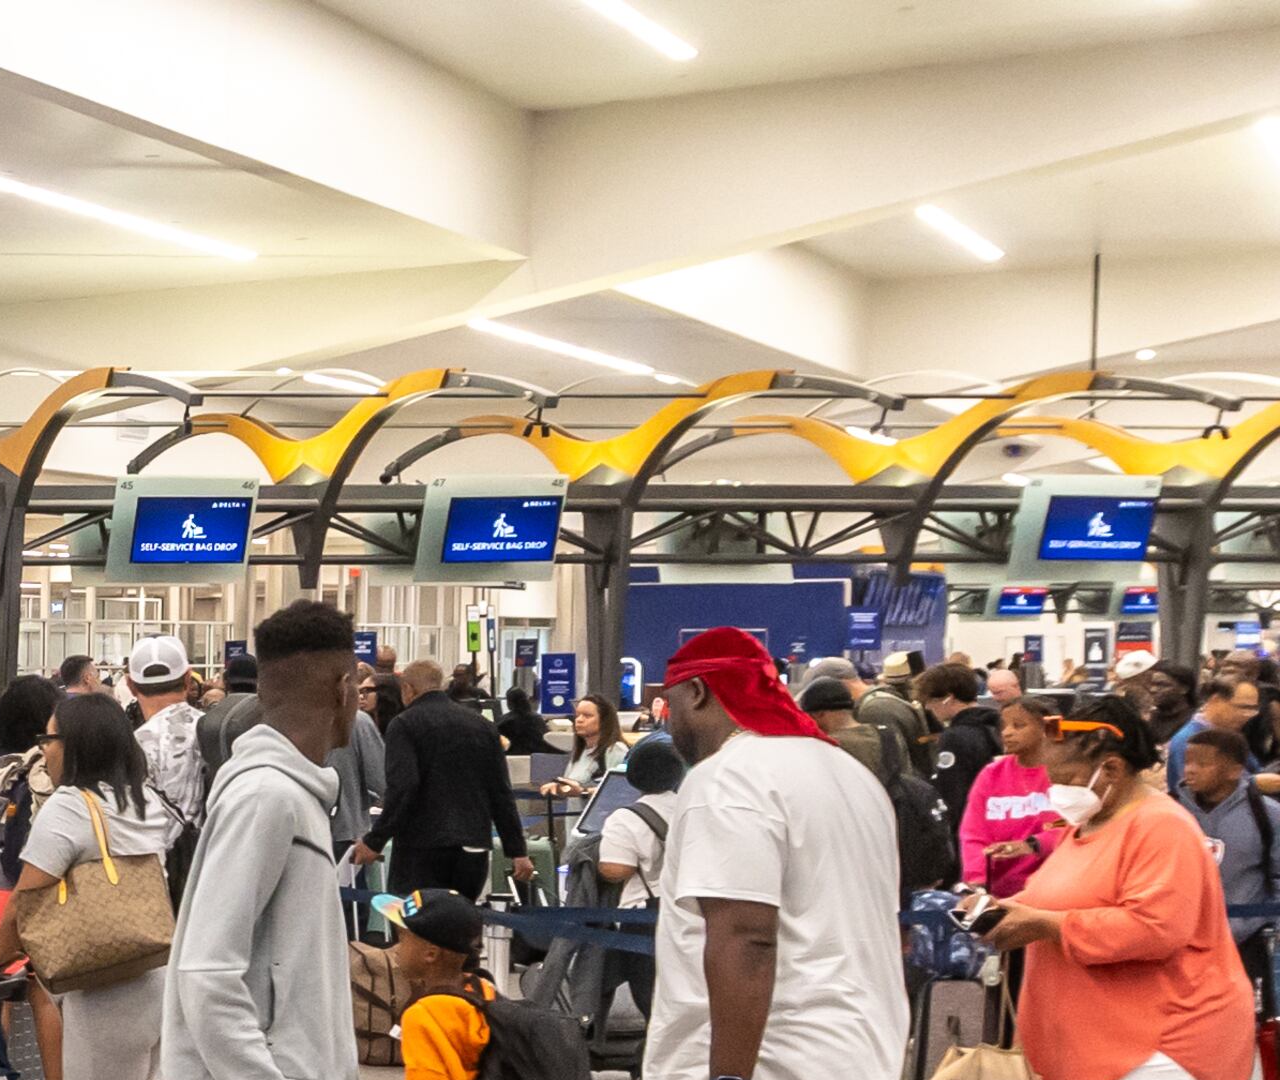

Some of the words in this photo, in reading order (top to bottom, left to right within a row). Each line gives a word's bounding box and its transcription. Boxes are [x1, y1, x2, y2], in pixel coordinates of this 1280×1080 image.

[121, 481, 134, 490] 45
[242, 481, 255, 490] 46
[432, 478, 446, 488] 47
[140, 543, 193, 551] SELF-SERVICE
[195, 543, 213, 551] BAG
[214, 543, 238, 551] DROP
[451, 541, 504, 551] SELF-SERVICE
[506, 541, 523, 550] BAG
[524, 541, 548, 550] DROP
